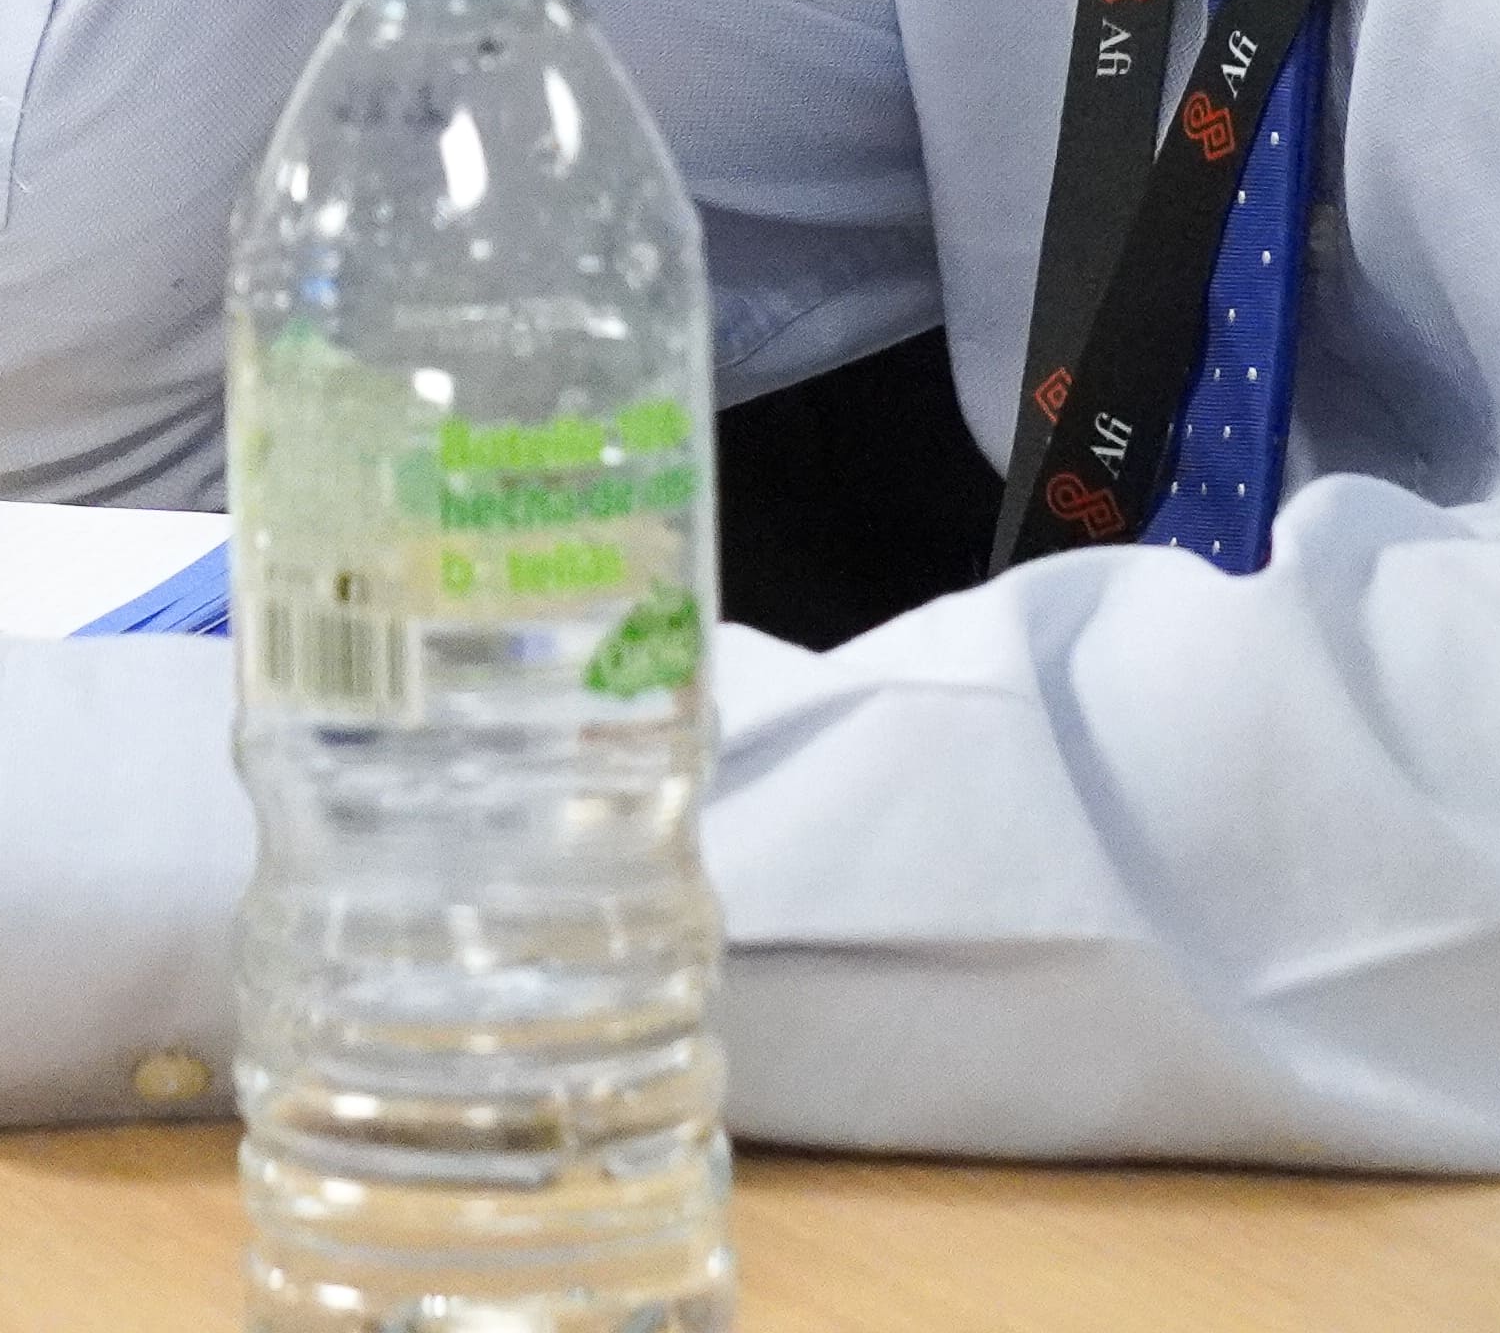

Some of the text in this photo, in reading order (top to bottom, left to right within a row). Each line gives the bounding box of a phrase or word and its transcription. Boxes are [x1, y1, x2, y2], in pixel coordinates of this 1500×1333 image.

[1096, 18, 1132, 76] Afi
[1220, 30, 1258, 99] Afi
[1090, 412, 1133, 479] Afi
